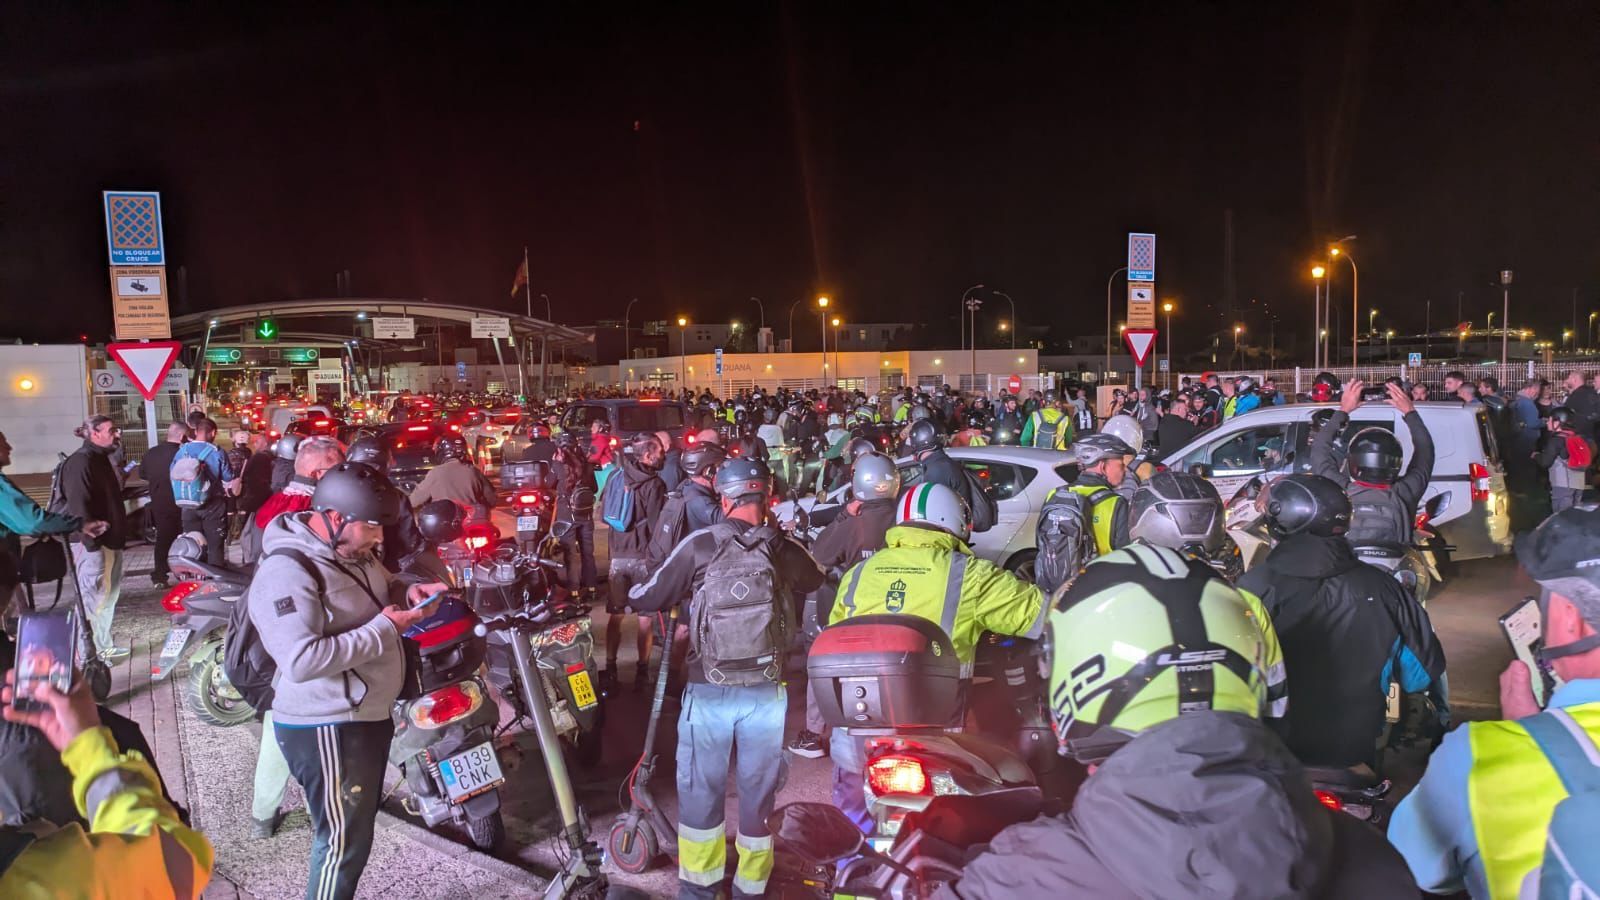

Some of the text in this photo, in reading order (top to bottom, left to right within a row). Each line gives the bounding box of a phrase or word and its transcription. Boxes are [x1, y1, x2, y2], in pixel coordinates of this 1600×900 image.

[1156, 648, 1227, 666] LS2
[452, 746, 492, 775] 8139
[458, 763, 493, 790] CNK
